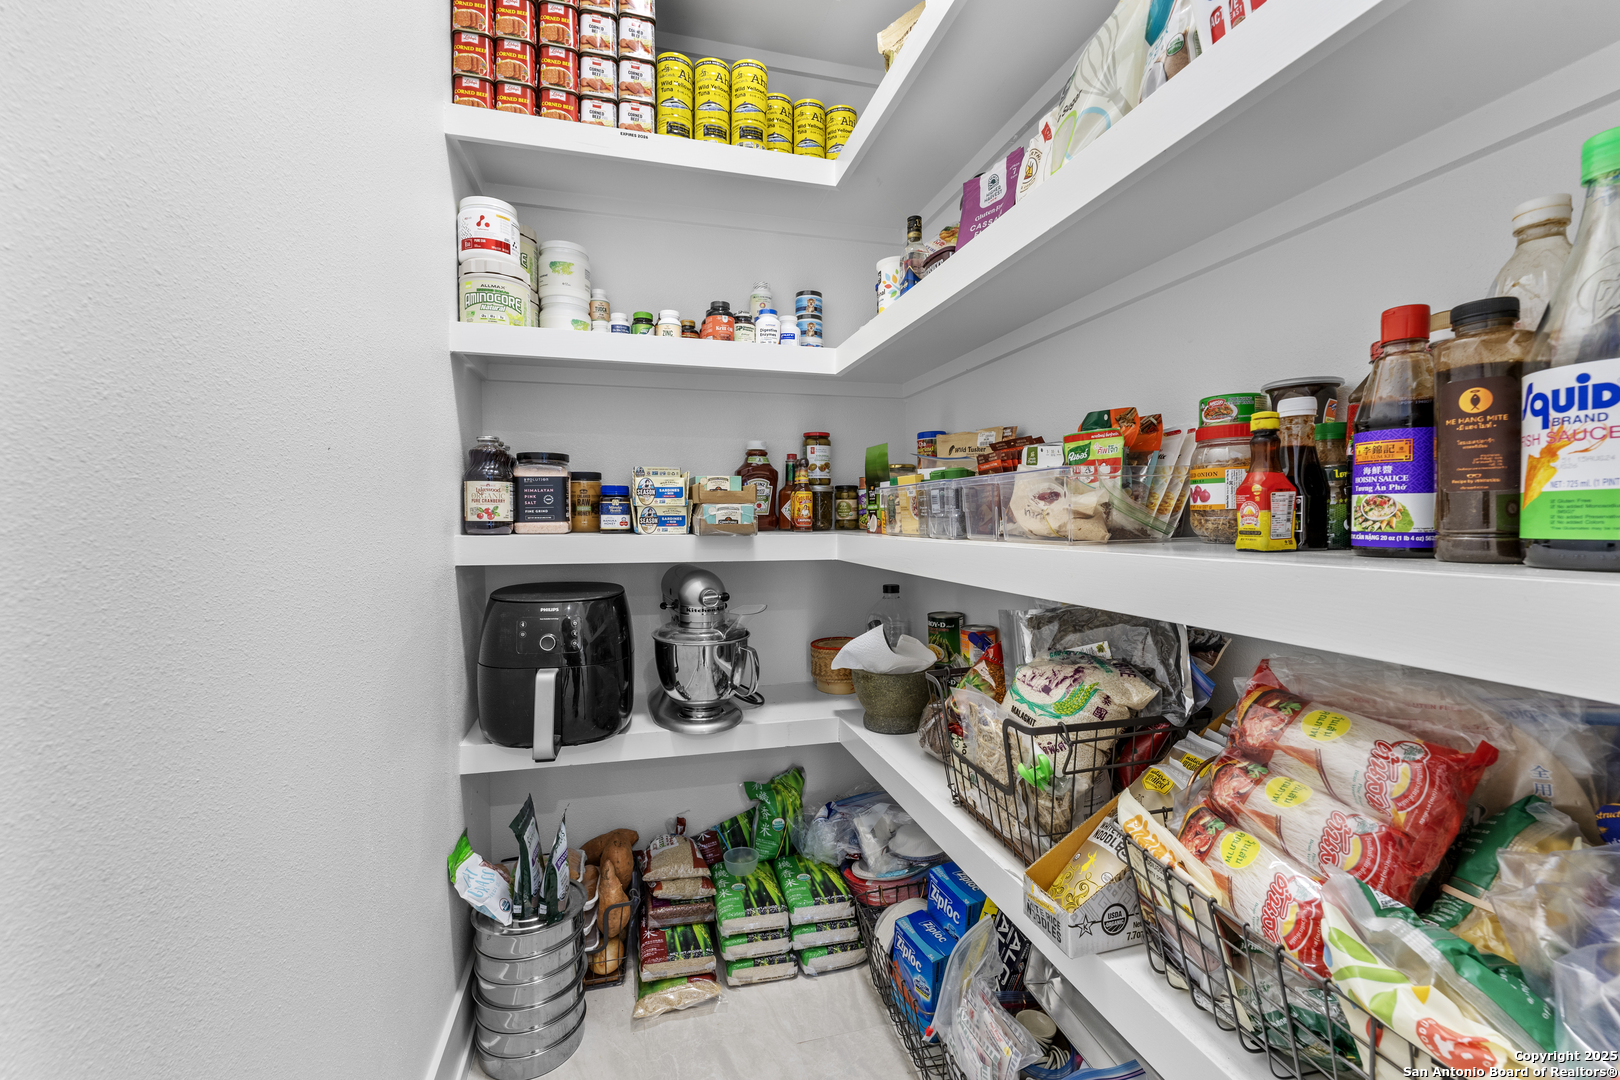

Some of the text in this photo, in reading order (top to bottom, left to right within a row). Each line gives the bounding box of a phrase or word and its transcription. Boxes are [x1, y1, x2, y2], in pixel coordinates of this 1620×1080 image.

[975, 207, 996, 222] Gluten
[465, 292, 522, 315] AMINOCORE
[480, 304, 506, 312] Natural
[1458, 416, 1485, 424] HANG
[1551, 412, 1609, 427] BRAND
[1546, 425, 1620, 445] SAUCE
[1355, 476, 1378, 484] HOISIN
[1566, 480, 1579, 488] 725
[468, 869, 496, 898] GRASS
[930, 883, 960, 925] Ziploc
[1108, 911, 1122, 920] USDA
[923, 921, 947, 943] Ziploc
[896, 936, 922, 973] Ziploc
